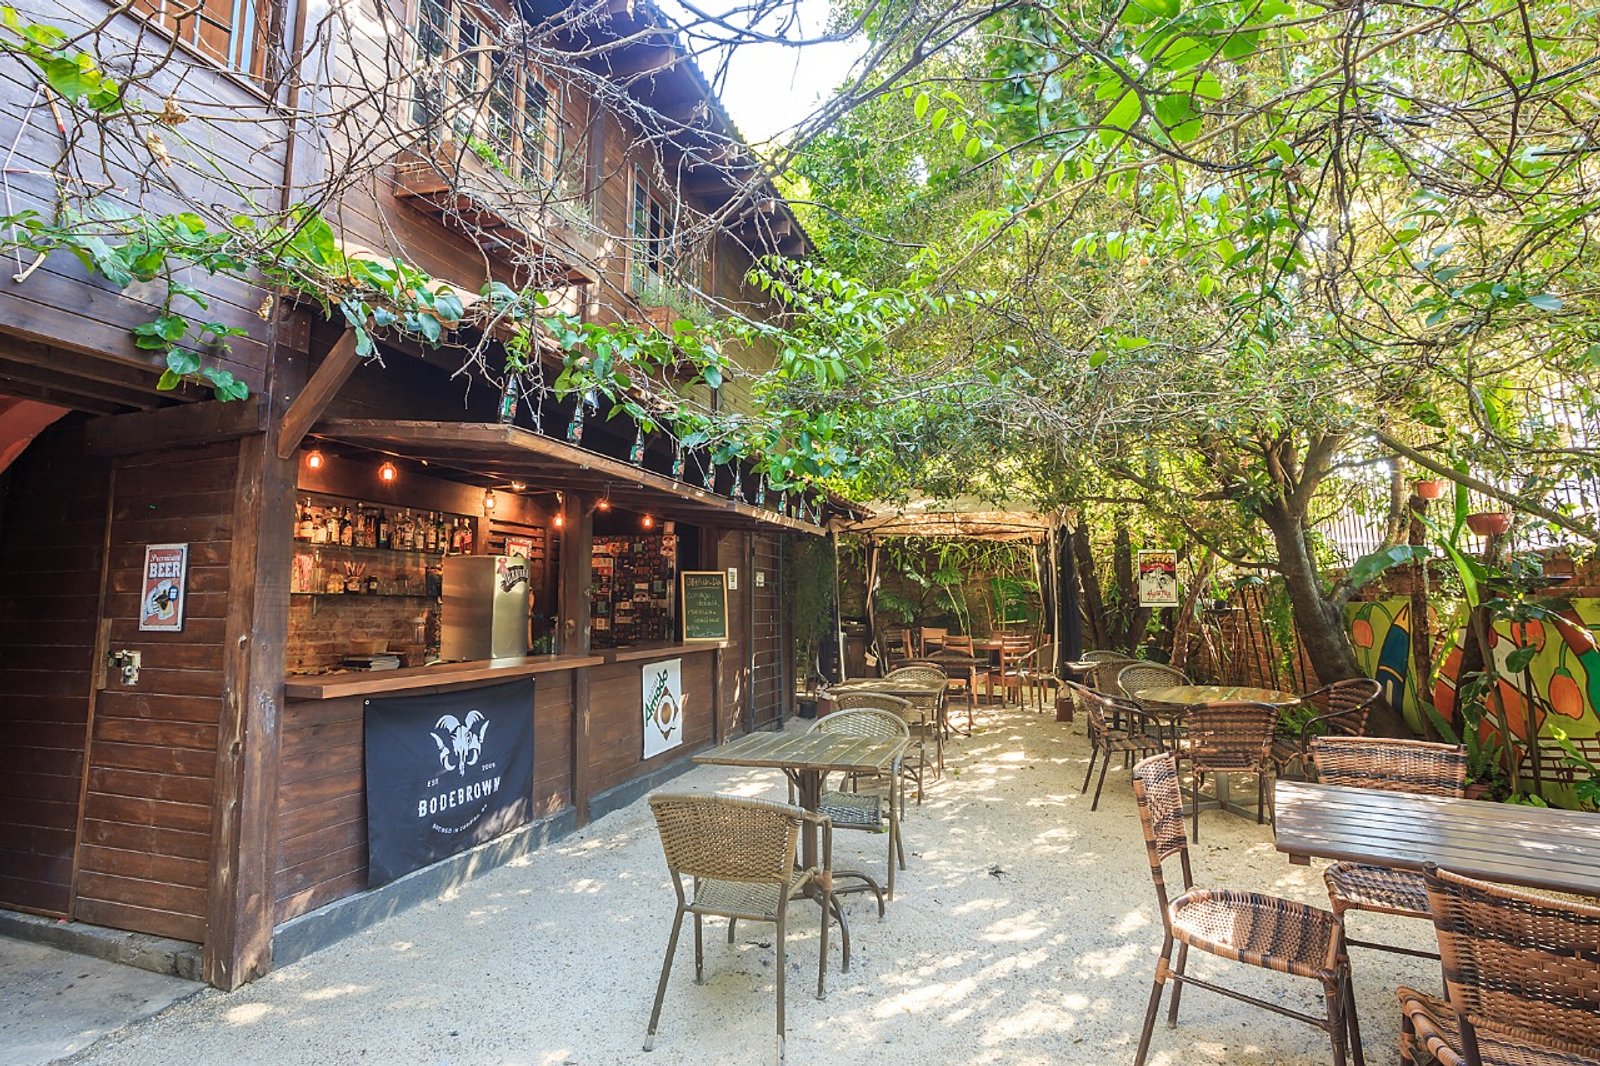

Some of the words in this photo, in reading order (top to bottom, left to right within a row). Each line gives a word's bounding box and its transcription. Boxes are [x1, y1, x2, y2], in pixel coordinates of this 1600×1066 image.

[149, 561, 180, 578] BEER
[645, 669, 668, 727] Amado
[418, 776, 501, 818] BODEBROWN
[427, 778, 439, 788] EST
